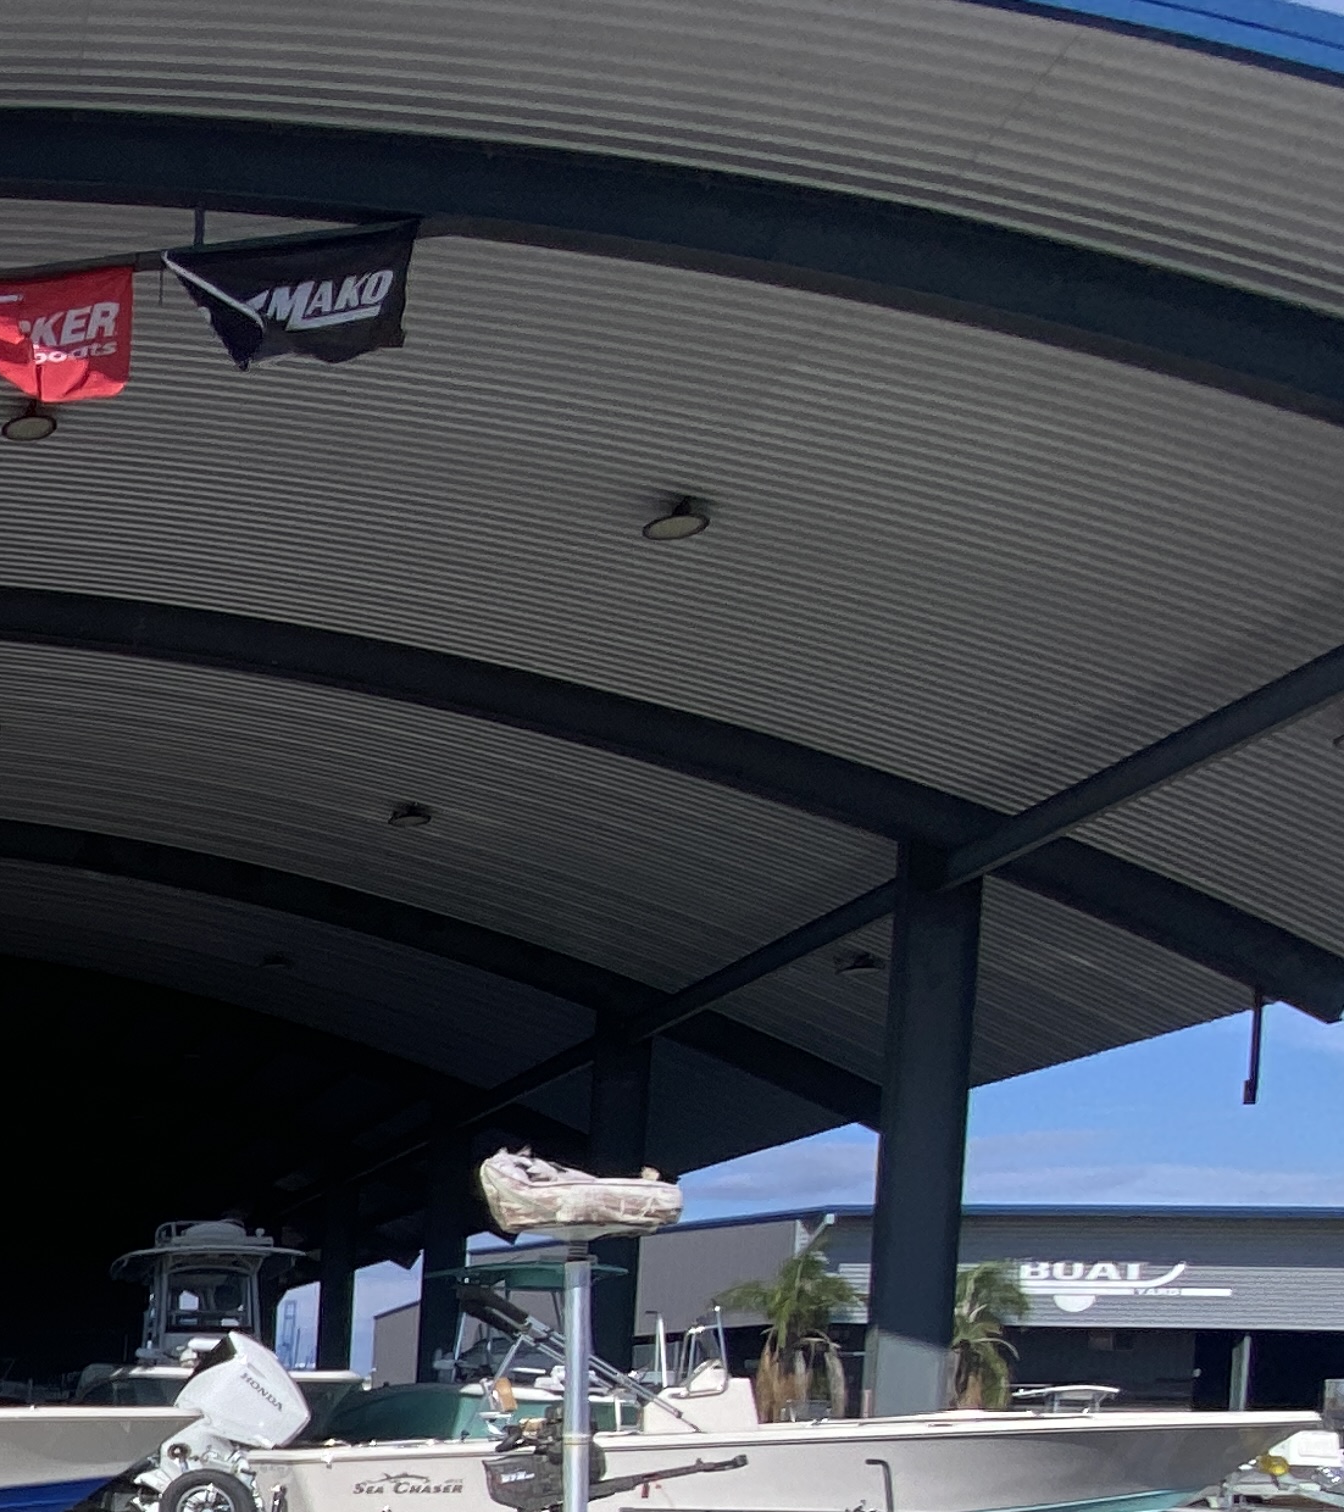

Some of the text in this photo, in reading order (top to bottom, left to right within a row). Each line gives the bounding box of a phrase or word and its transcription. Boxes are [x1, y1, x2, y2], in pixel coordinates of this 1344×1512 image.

[266, 269, 395, 331] MAKO
[19, 301, 120, 346] KER
[239, 1372, 283, 1412] HONDA
